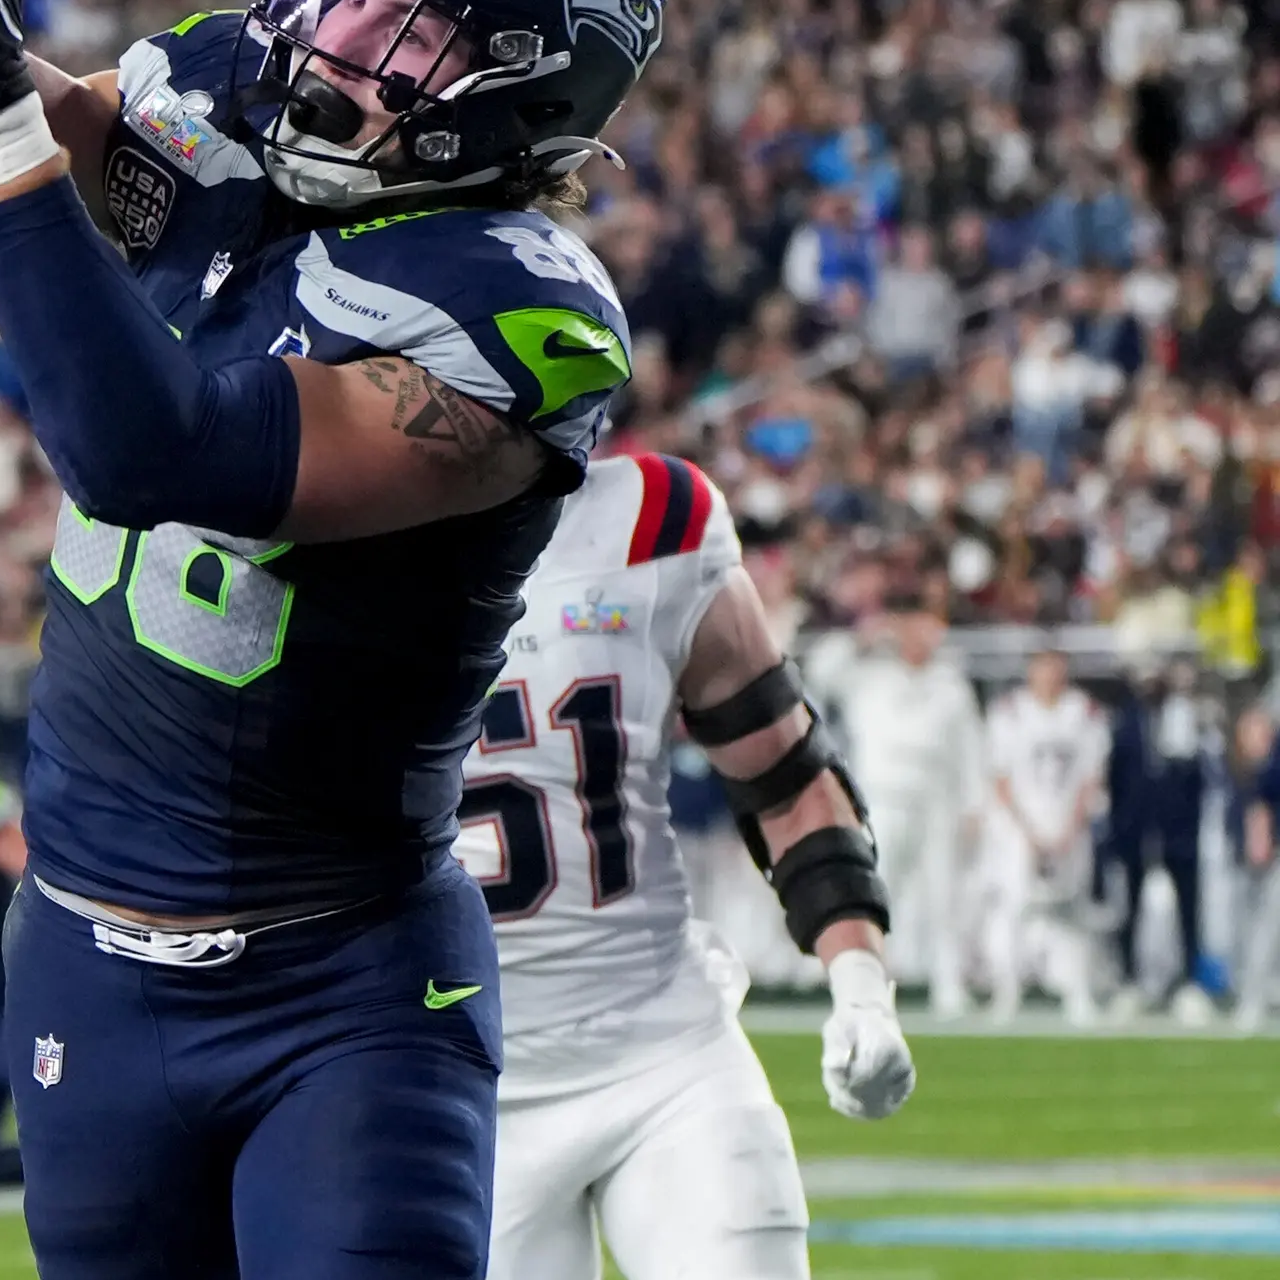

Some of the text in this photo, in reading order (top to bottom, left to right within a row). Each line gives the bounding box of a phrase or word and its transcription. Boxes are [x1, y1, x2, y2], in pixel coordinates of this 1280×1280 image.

[115, 161, 167, 208] USA
[109, 191, 160, 243] 250
[456, 674, 636, 922] 51
[37, 1057, 57, 1078] NFL
